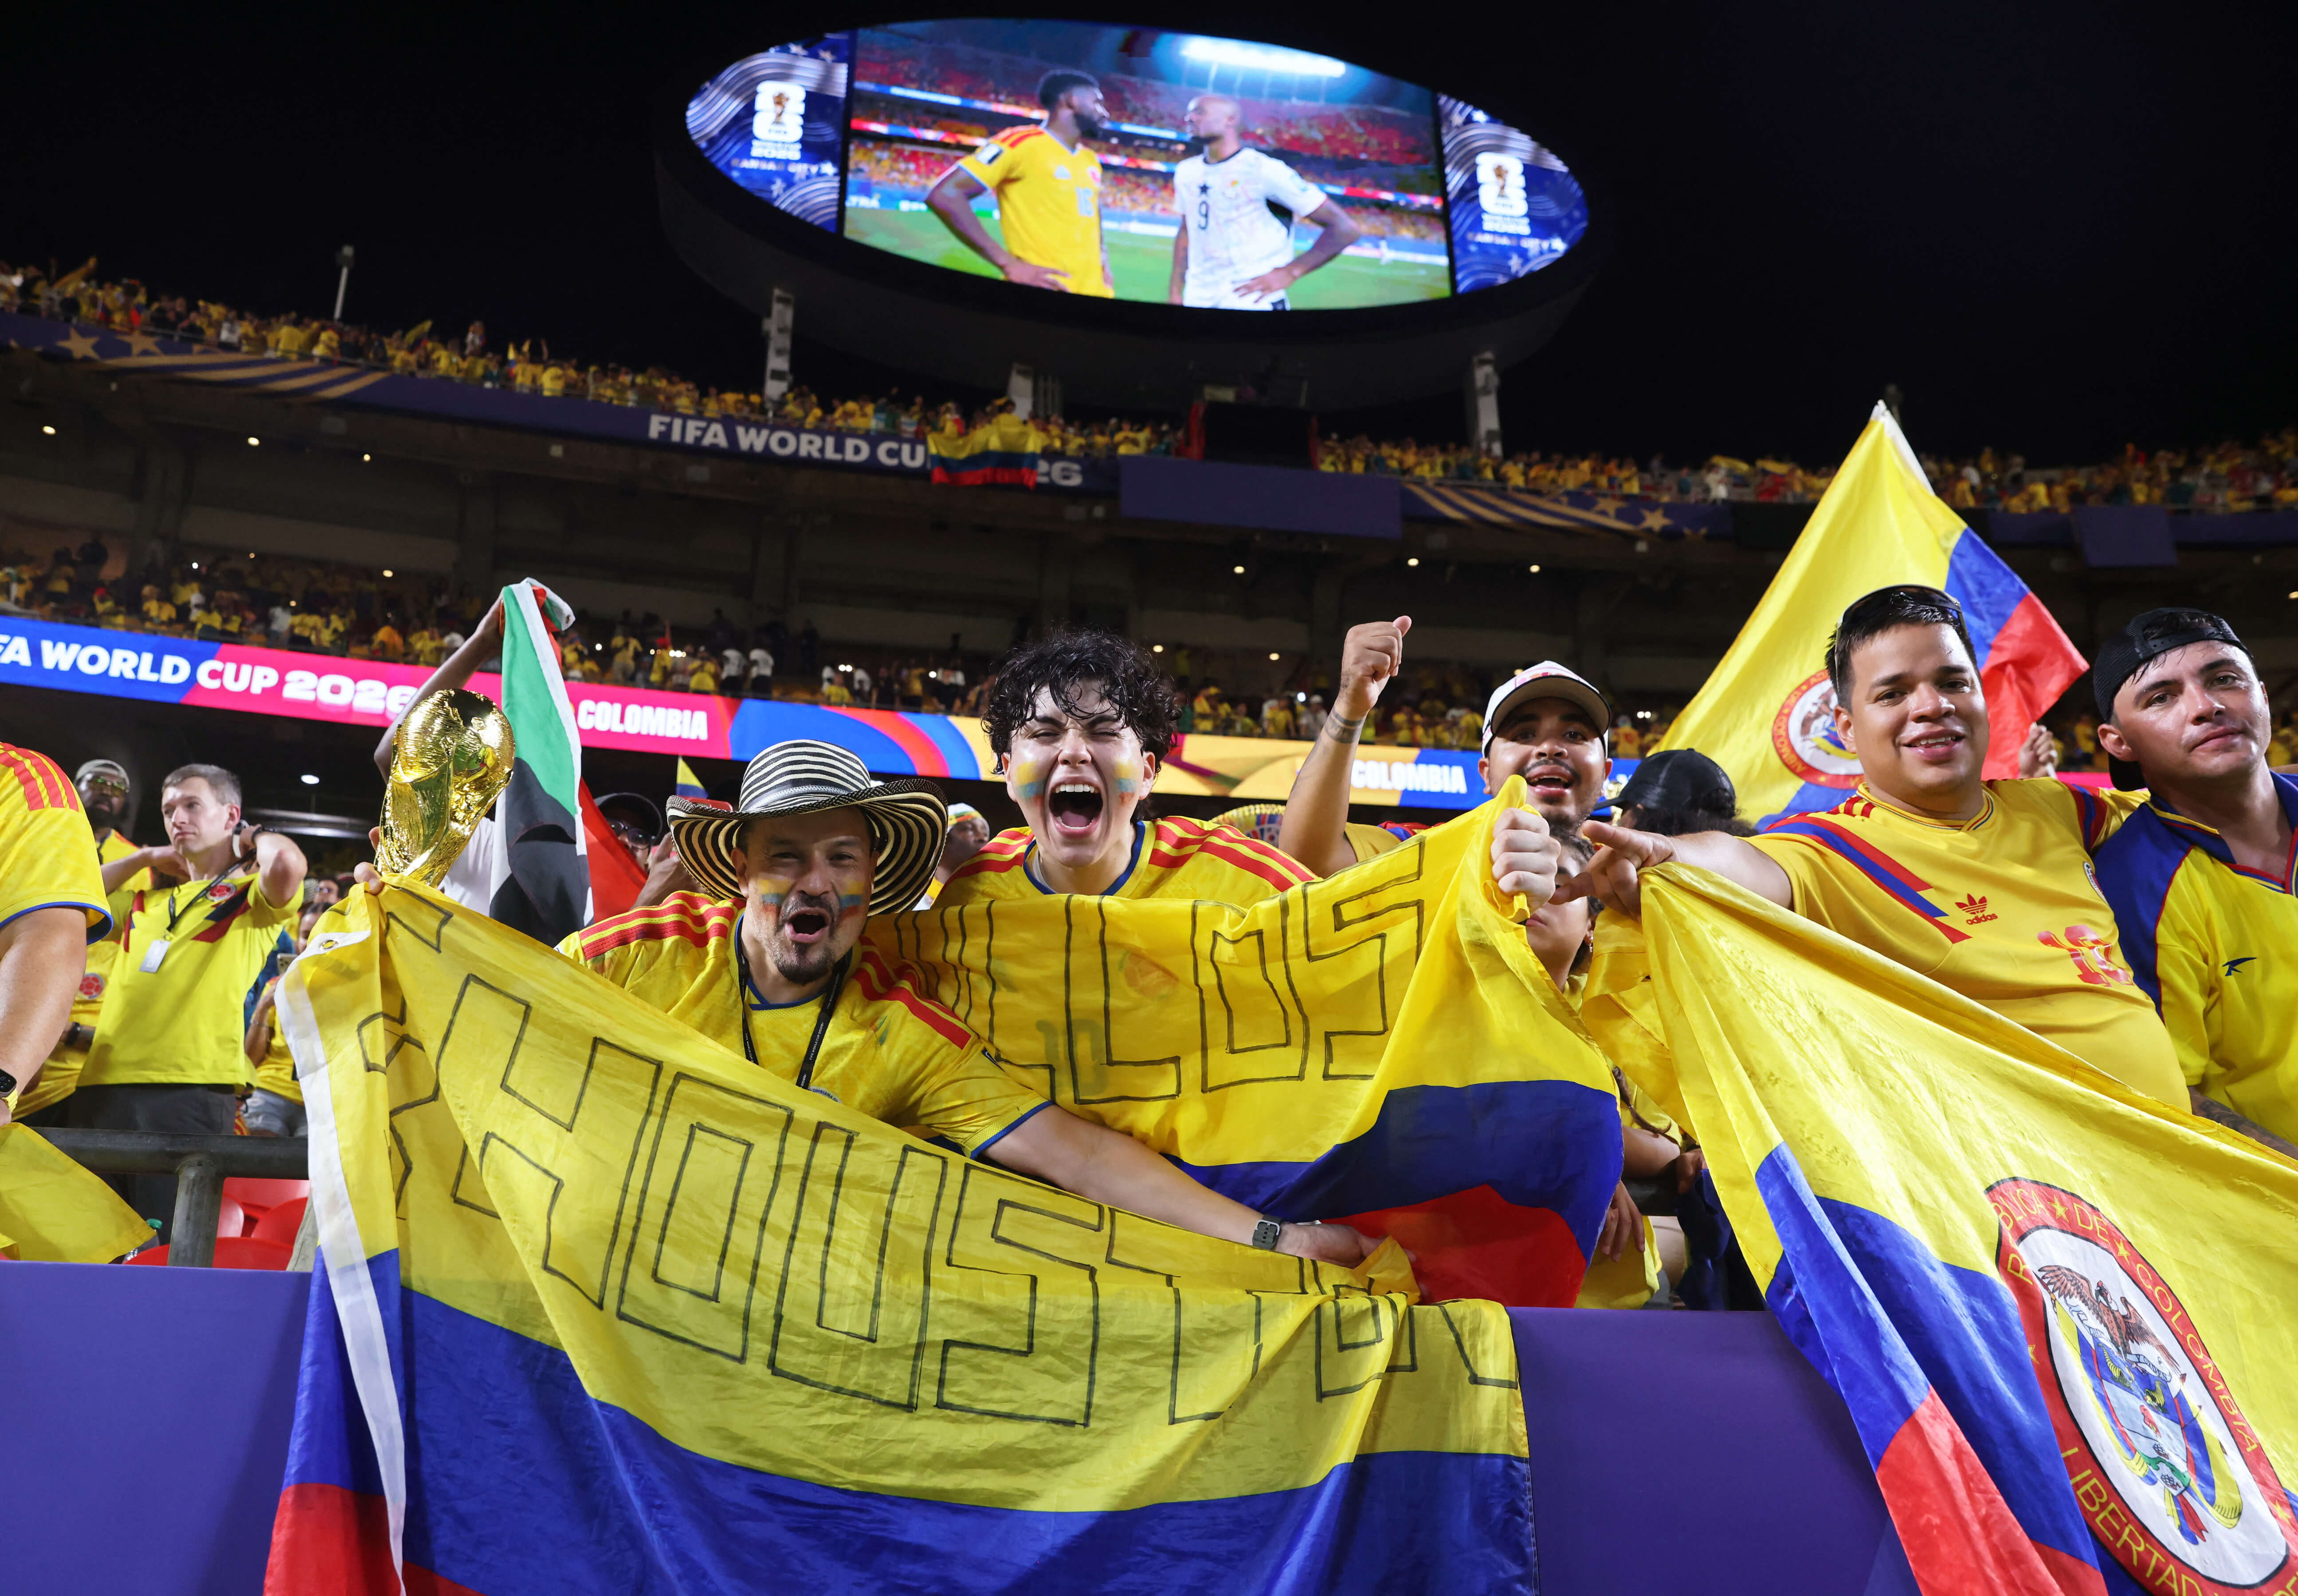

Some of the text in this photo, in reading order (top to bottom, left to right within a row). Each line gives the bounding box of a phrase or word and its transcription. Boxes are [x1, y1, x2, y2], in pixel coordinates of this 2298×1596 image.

[1198, 200, 1209, 231] 9
[648, 414, 1082, 486] FIFA WORLD CU 26
[41, 639, 191, 684] WORLD
[196, 659, 279, 695] CUP
[282, 670, 418, 715] 2026
[577, 700, 708, 740] COLOMBIA
[1351, 759, 1467, 794] COLOMBIA
[1966, 912, 1998, 926] adidas
[810, 1088, 833, 1099] OMBIANA
[2073, 1202, 2111, 1245] DE
[2136, 1263, 2258, 1453] COLOMBIA
